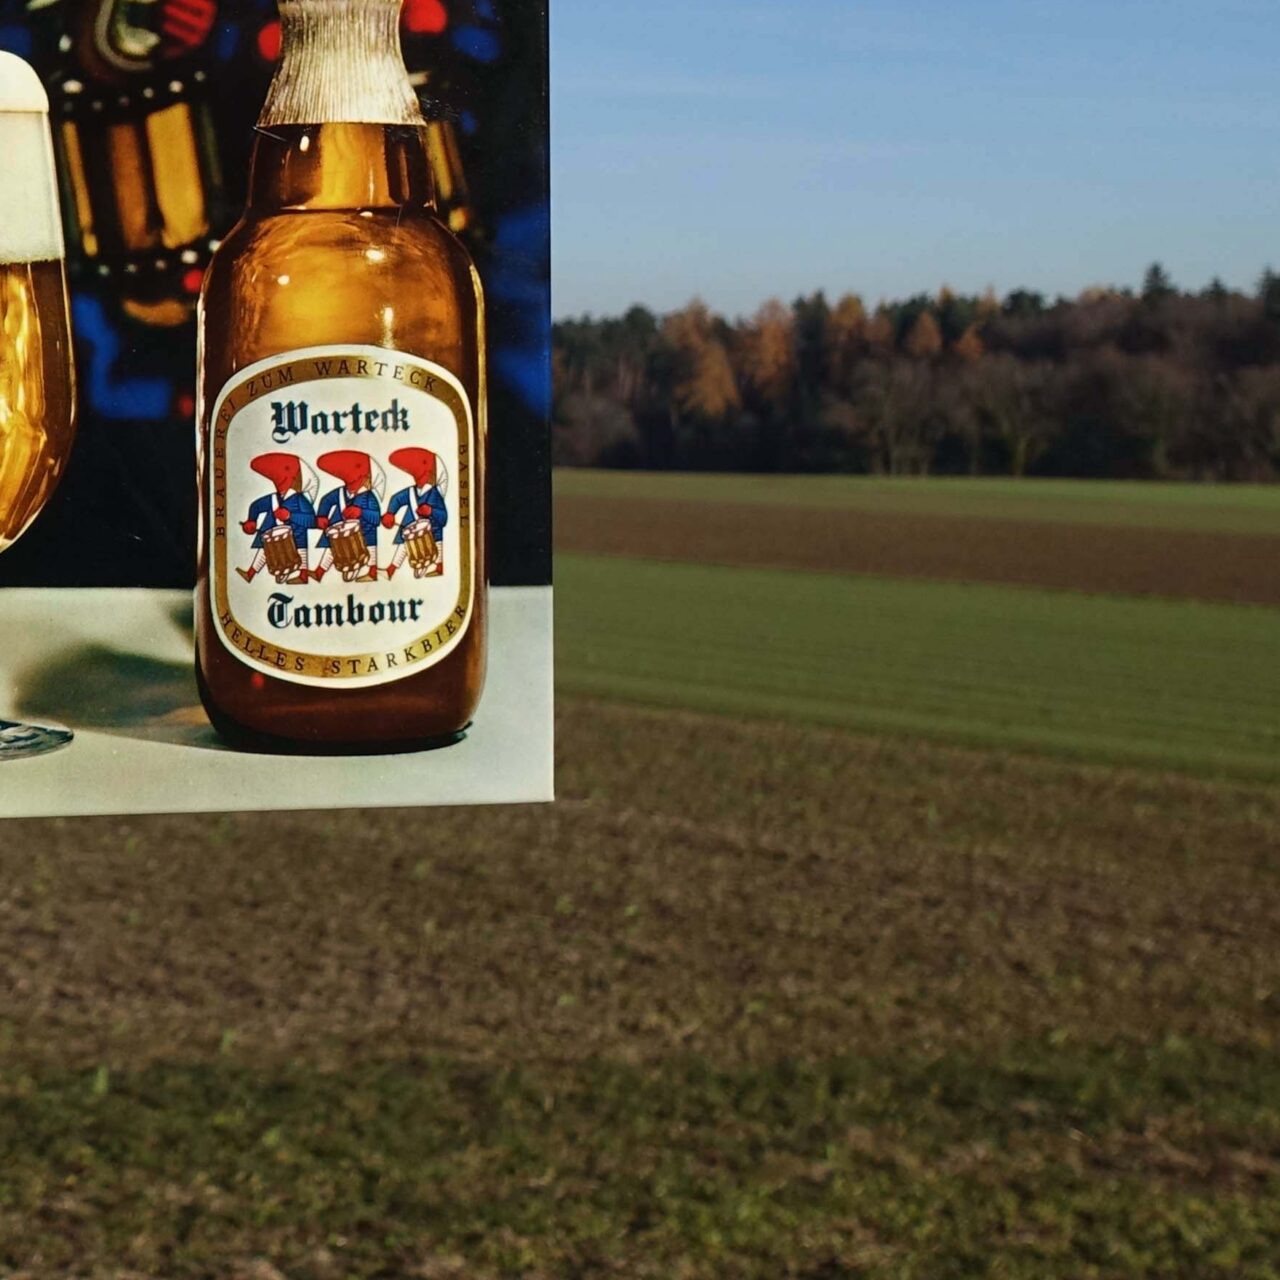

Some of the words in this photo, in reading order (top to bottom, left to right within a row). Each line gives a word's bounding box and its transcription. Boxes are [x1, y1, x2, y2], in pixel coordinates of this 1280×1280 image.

[215, 399, 237, 536] BRAUEREI
[247, 366, 294, 397] ZUM
[313, 359, 437, 392] WARTECK
[459, 444, 469, 527] BASEL
[271, 398, 410, 444] Warteck
[221, 612, 305, 671] HELLES
[331, 604, 467, 672] STARKBIER
[267, 592, 424, 629] Tambour
